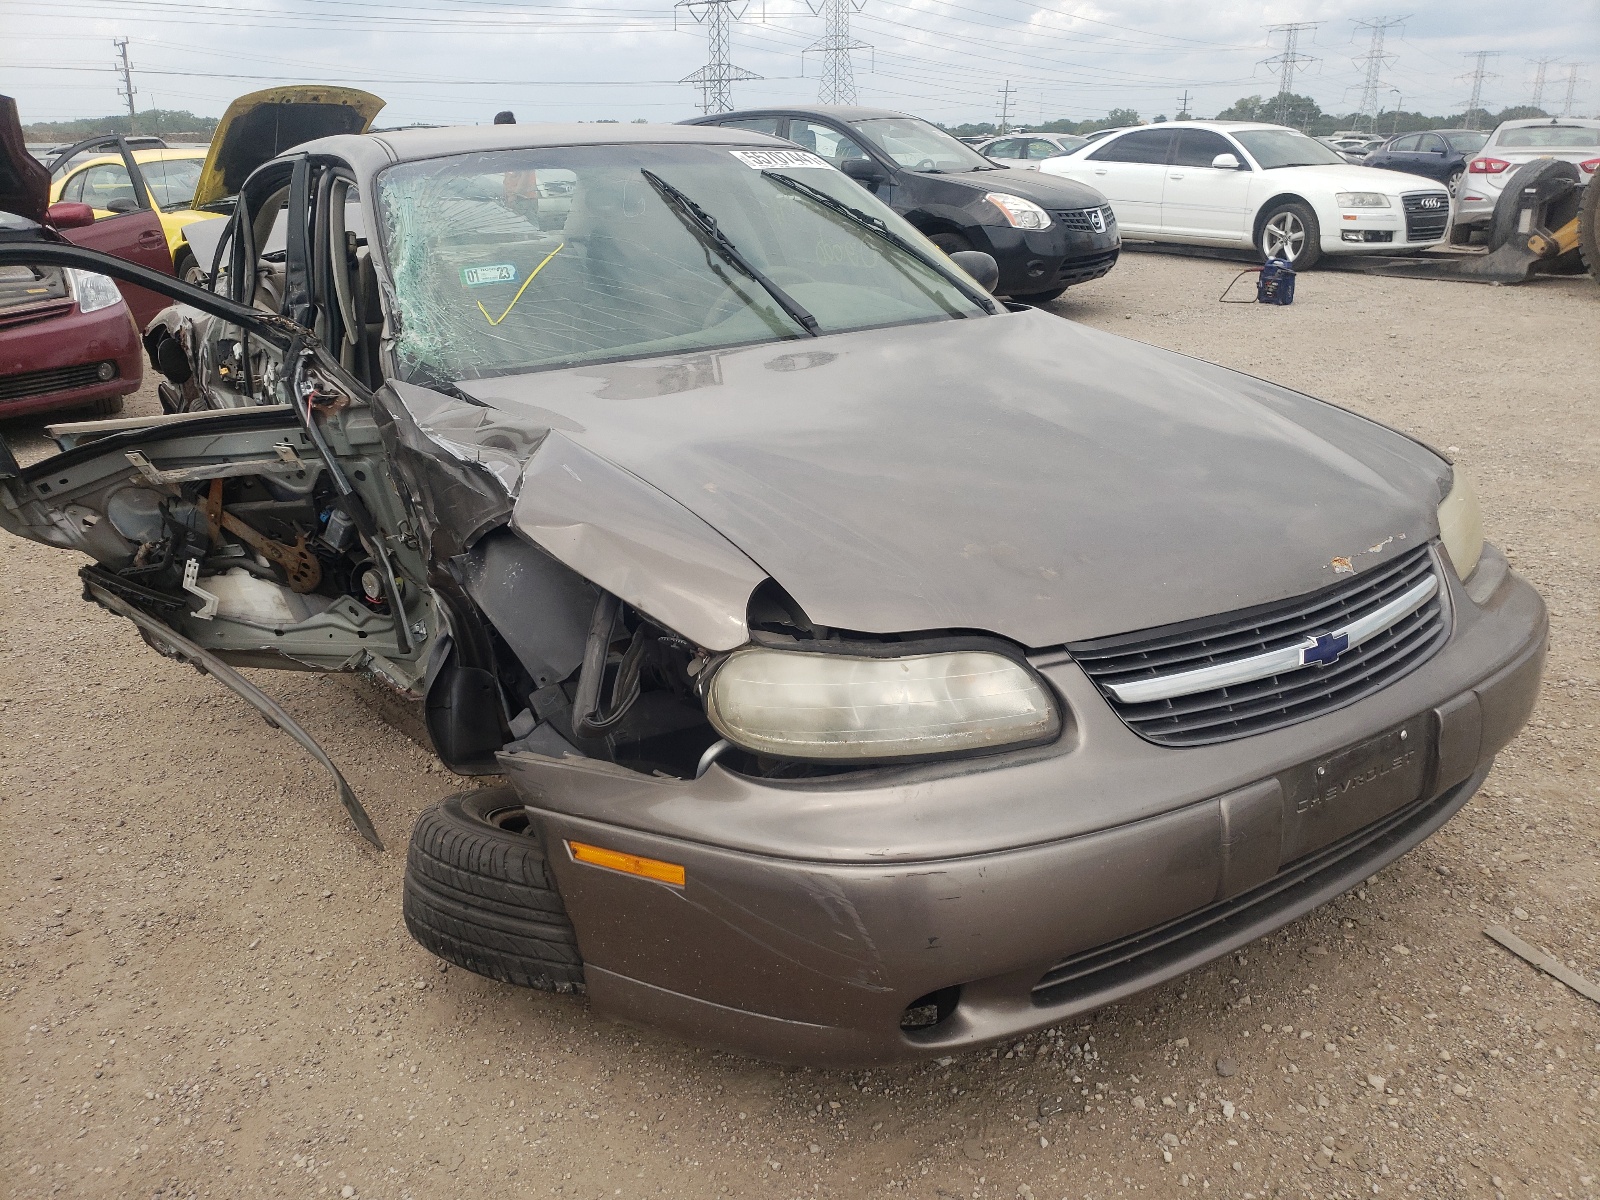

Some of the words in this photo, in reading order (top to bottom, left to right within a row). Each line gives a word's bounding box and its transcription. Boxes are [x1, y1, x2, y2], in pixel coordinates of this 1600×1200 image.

[741, 151, 821, 165] 55707441
[467, 269, 480, 283] 01
[498, 267, 511, 280] 23
[1297, 751, 1415, 813] CHEVROLET
